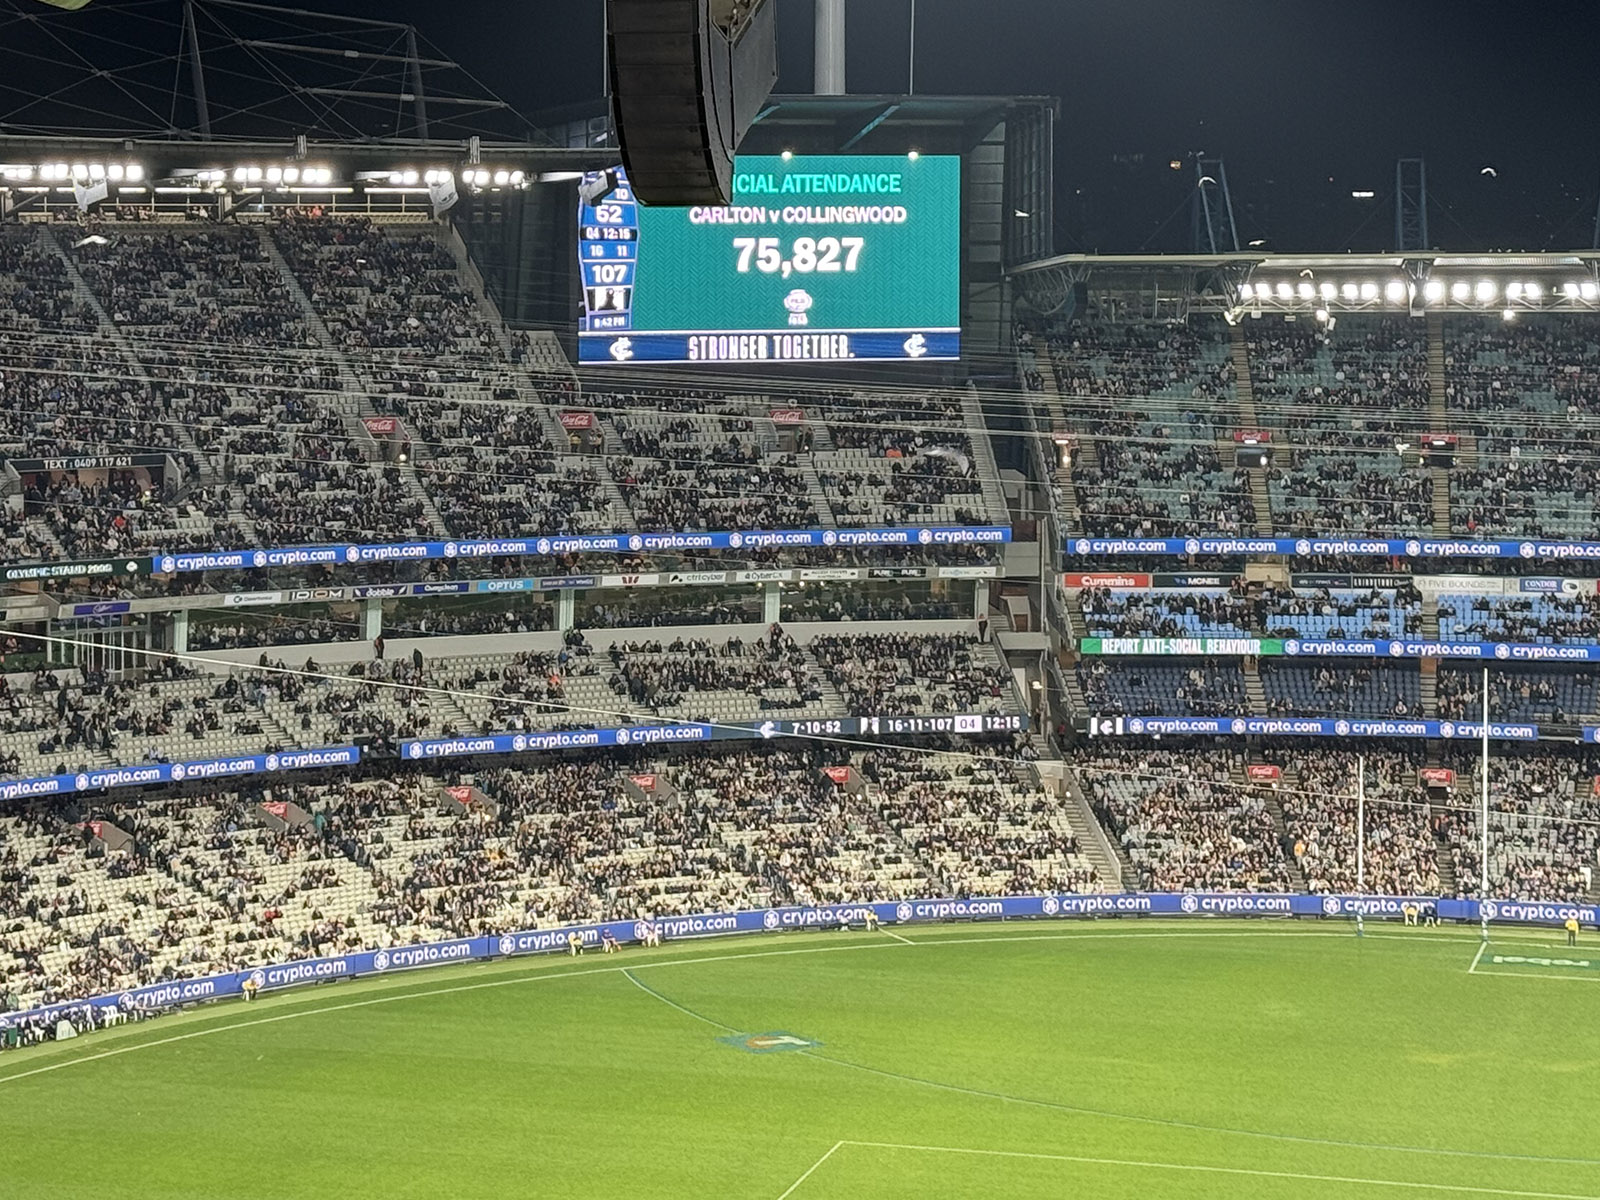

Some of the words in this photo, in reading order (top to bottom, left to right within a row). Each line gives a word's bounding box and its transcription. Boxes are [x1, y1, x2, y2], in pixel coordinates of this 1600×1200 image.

[733, 174, 778, 193] ICIAL
[781, 174, 902, 193] ATTENDANCE
[596, 204, 622, 223] 52
[689, 206, 766, 224] CARLTON
[769, 209, 780, 223] v
[782, 205, 907, 224] COLLINGWOOD
[603, 227, 630, 240] 12:15
[617, 244, 628, 257] 11
[733, 237, 864, 278] 75,827
[592, 264, 627, 283] 107
[689, 335, 768, 360] STRONGER
[773, 334, 855, 359] TOGETHER.
[43, 459, 68, 470] TEXT
[74, 458, 96, 468] 0409
[99, 457, 115, 467] 117
[116, 456, 132, 466] 621
[644, 534, 712, 550] crypto.com
[744, 531, 812, 547] crypto.com
[838, 530, 908, 545] crypto.com
[934, 529, 1003, 544] crypto.com
[361, 544, 427, 561] crypto.com
[459, 541, 527, 557] crypto.com
[552, 537, 618, 554] crypto.com
[1093, 540, 1166, 554] crypto.com
[1202, 540, 1276, 555] crypto.com
[1313, 541, 1388, 556] crypto.com
[1423, 542, 1500, 557] crypto.com
[1538, 544, 1600, 558] crypto.co
[176, 554, 243, 571] crypto.com
[268, 549, 336, 566] crypto.com
[488, 580, 524, 591] OPTUS
[1080, 575, 1136, 587] Cummins
[1525, 579, 1558, 588] CONDOR
[1101, 638, 1140, 654] REPORT
[1142, 638, 1204, 654] ANTI-SOCIAL
[1206, 638, 1262, 654] BEHAVIOUR
[1302, 641, 1376, 656] crypto.com
[1406, 643, 1481, 658] crypto.com
[1512, 646, 1589, 660] crypto.com
[985, 716, 1020, 730] 12:15
[1147, 720, 1219, 733] crypto.com
[1249, 721, 1322, 734] crypto.com
[1352, 722, 1426, 736] crypto.com
[529, 731, 599, 749] crypto.com
[632, 726, 703, 744] crypto.com
[425, 737, 495, 756] crypto.com
[281, 749, 350, 769] crypto.com
[187, 758, 256, 777] crypto.com
[90, 769, 160, 788] crypto.com
[0, 780, 59, 799] rypto.com
[915, 899, 1003, 918] crypto.com
[1062, 895, 1152, 913] crypto.com
[1201, 895, 1291, 913] crypto.com
[1501, 905, 1596, 922] crypto.com
[655, 917, 737, 936] crypto.com
[392, 942, 470, 966] crypto.com
[268, 958, 347, 985] crypto.com
